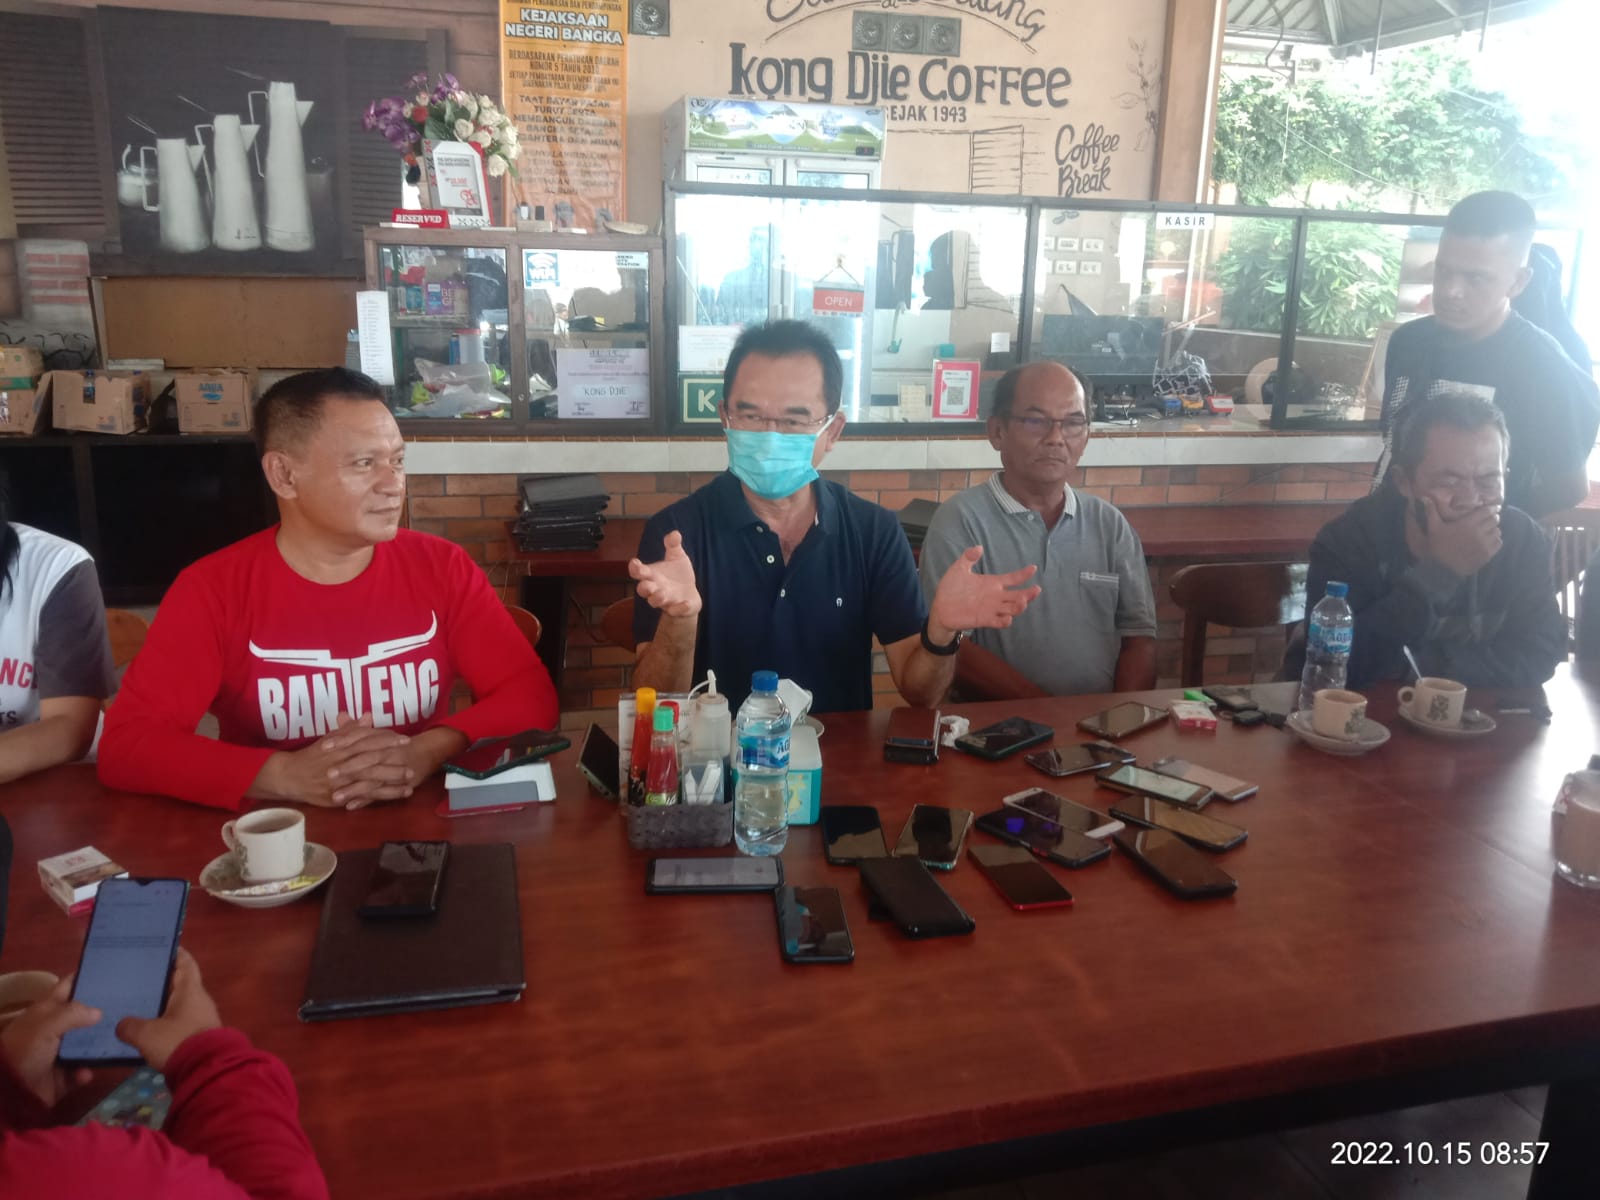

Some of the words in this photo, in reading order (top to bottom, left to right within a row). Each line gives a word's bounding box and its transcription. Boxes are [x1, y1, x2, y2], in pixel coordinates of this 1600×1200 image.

[520, 7, 608, 28] KEJAKSAAN
[505, 22, 559, 40] NEGERI
[561, 27, 624, 45] BANGKA
[560, 63, 581, 73] TAHUN
[519, 95, 544, 106] TAAT
[534, 105, 565, 115] TURUT
[887, 105, 927, 122] EJAK
[933, 105, 967, 123] 1943
[1055, 122, 1120, 170] Coffee
[1057, 155, 1112, 198] Break
[395, 214, 442, 224] RESERVED
[1165, 216, 1206, 226] KASIR
[824, 296, 853, 307] OPEN
[257, 645, 440, 741] BANTENG
